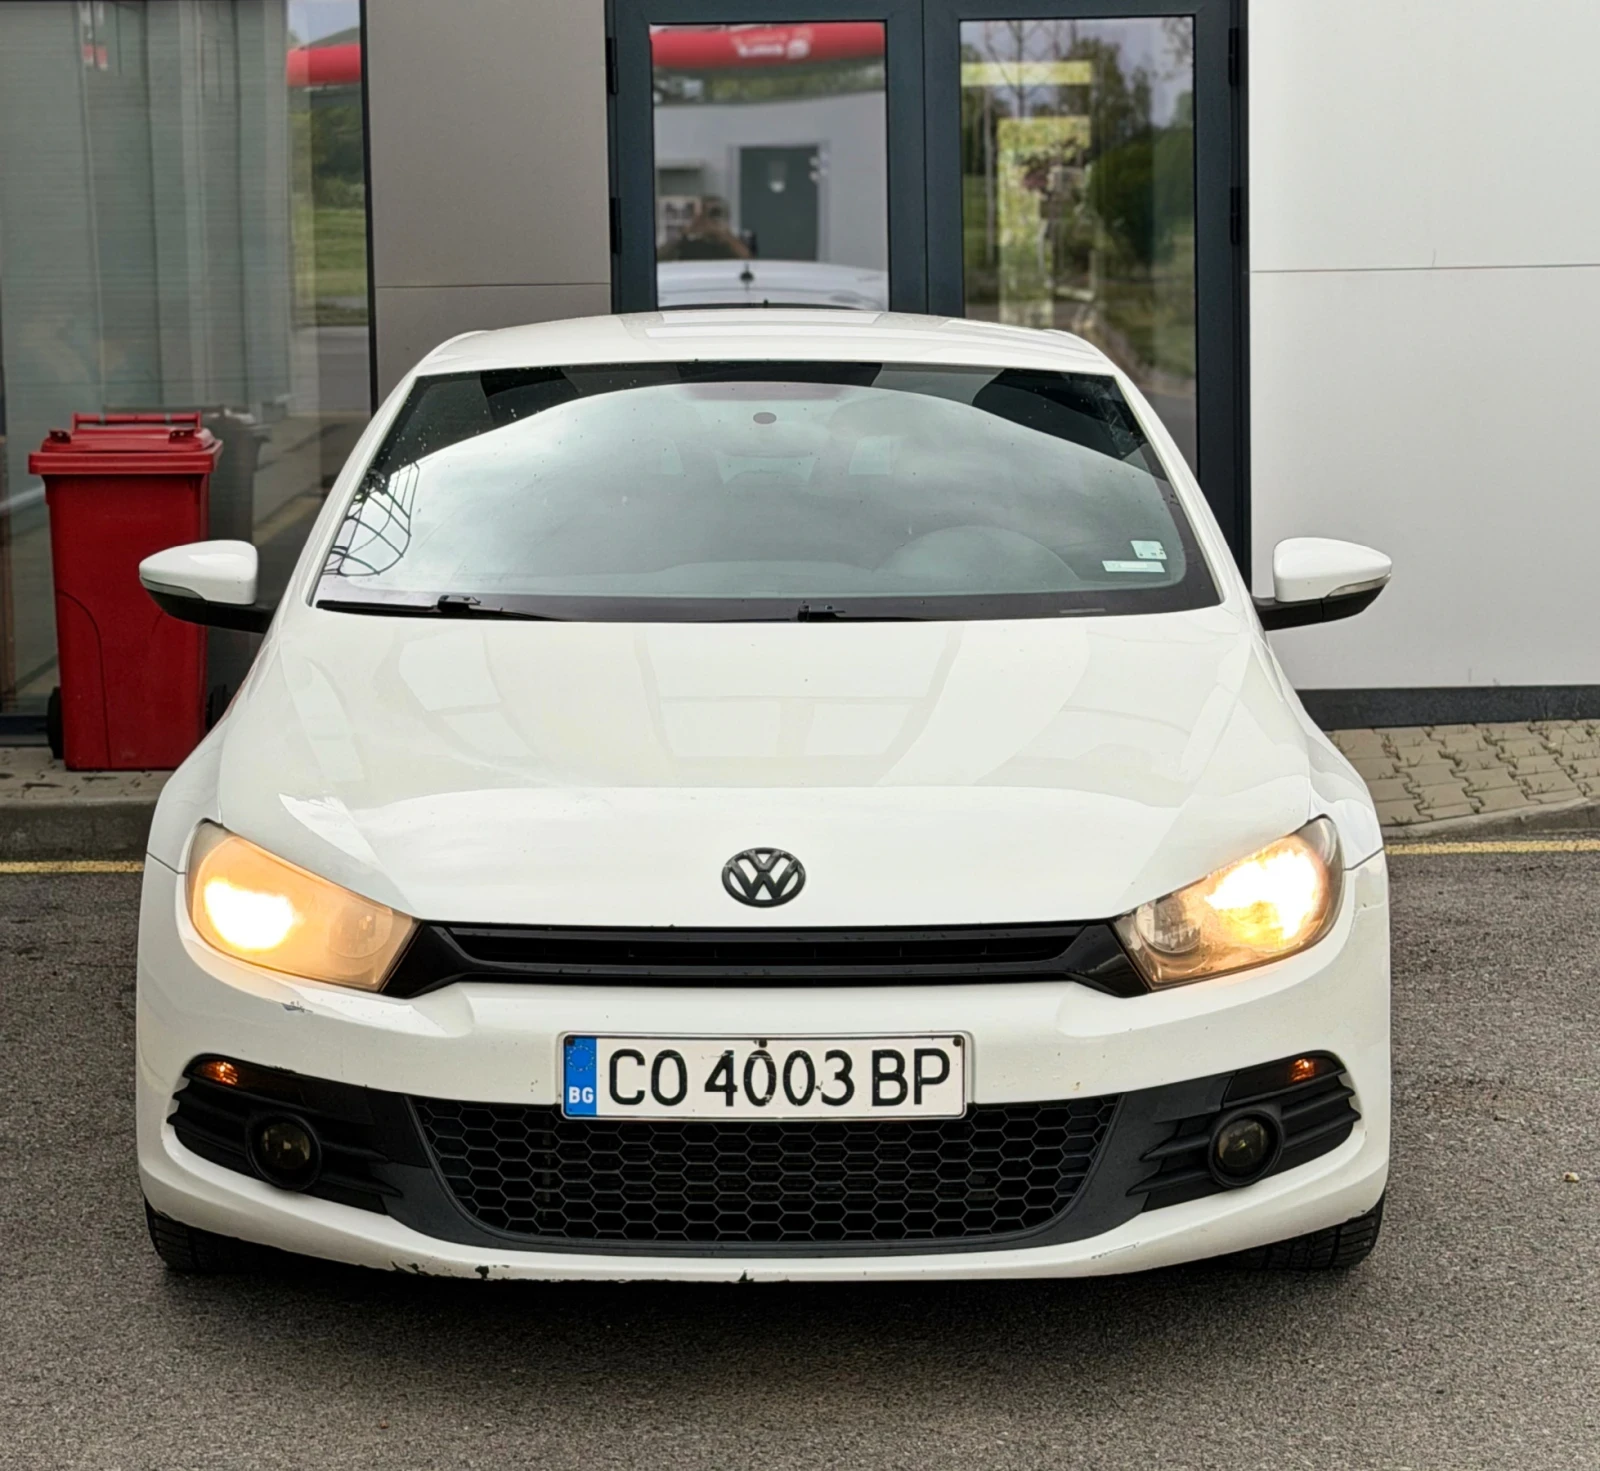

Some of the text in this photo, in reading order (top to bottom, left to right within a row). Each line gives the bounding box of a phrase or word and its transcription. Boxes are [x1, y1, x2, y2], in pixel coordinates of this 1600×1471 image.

[721, 846, 806, 908] VW
[568, 1086, 595, 1105] BG
[609, 1047, 951, 1107] CO 4003 BP
